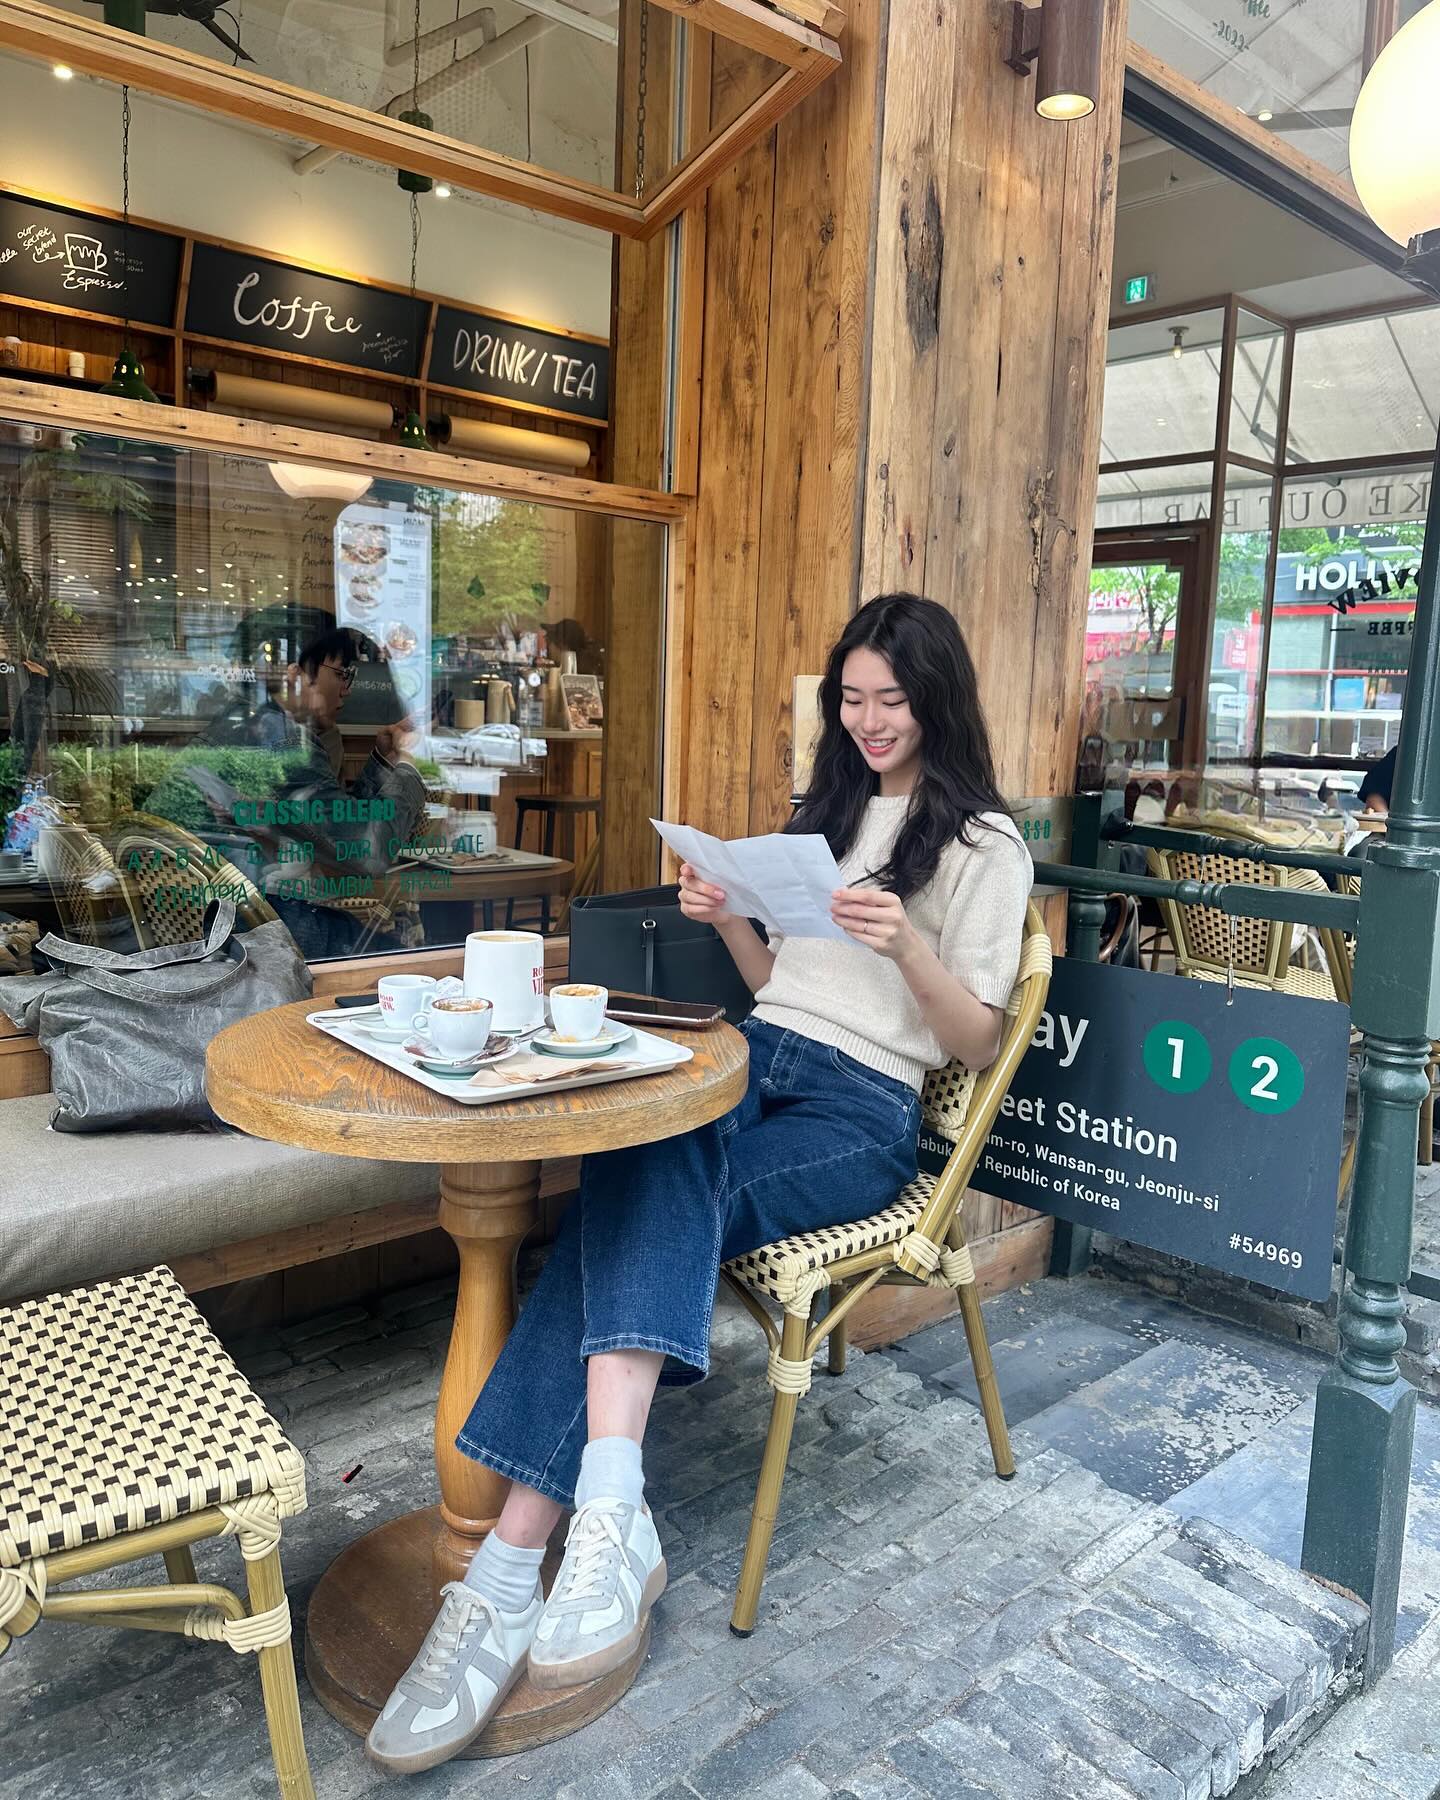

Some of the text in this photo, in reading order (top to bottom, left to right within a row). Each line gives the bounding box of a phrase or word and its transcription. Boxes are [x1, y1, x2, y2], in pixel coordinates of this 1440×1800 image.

[17, 224, 36, 239] our
[23, 227, 52, 250] secret
[34, 233, 57, 255] blend
[233, 797, 396, 827] CLASSIC BLEND
[278, 874, 374, 902] COLOMBIA
[1167, 1037, 1185, 1079] 1
[1250, 1055, 1280, 1100] 2
[1001, 1094, 1178, 1162] eet Station
[985, 1155, 1049, 1188] Republic
[1053, 1178, 1071, 1195] of
[1074, 1182, 1121, 1211] Korea
[1035, 1143, 1130, 1188] Wansan-gu,
[1134, 1174, 1220, 1212] Jeonju-si
[1229, 1232, 1303, 1270] #54969
